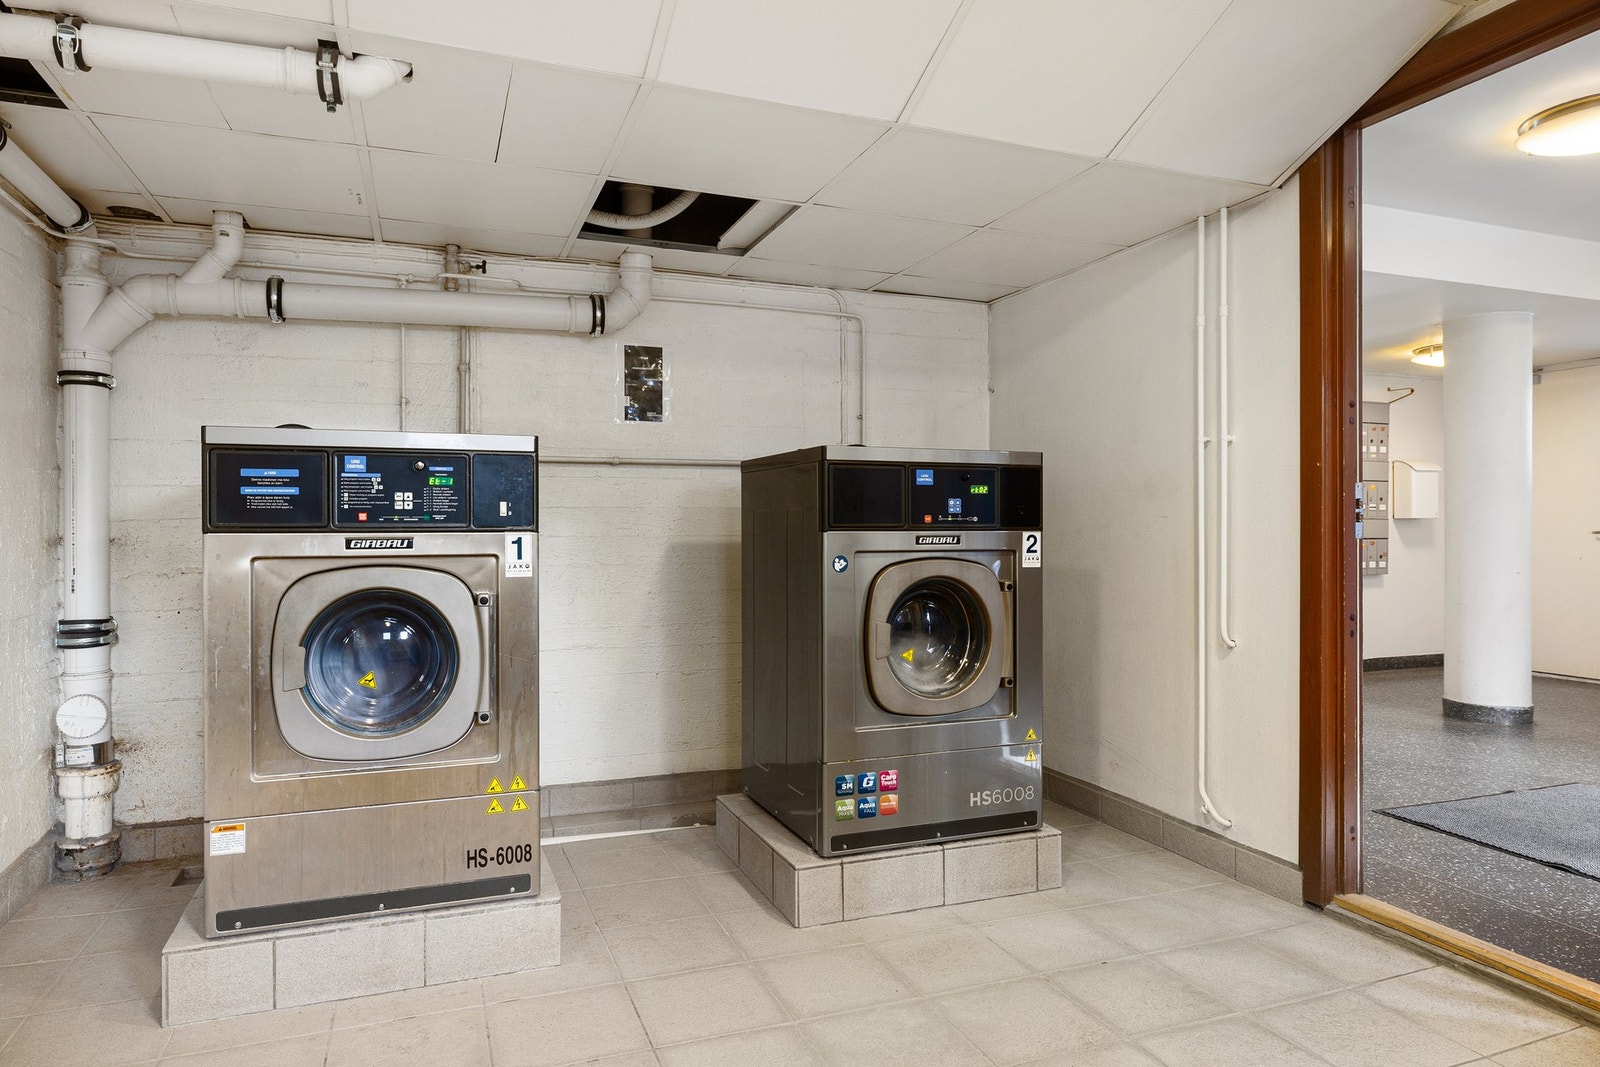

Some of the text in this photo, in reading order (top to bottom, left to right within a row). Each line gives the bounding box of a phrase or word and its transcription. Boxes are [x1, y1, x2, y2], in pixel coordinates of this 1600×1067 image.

[350, 539, 409, 548] GIRBAU
[511, 536, 523, 560] 1
[919, 536, 958, 544] GIRBAU
[1026, 534, 1038, 554] 2
[969, 785, 1035, 807] HS6008
[466, 843, 532, 869] HS-6008
